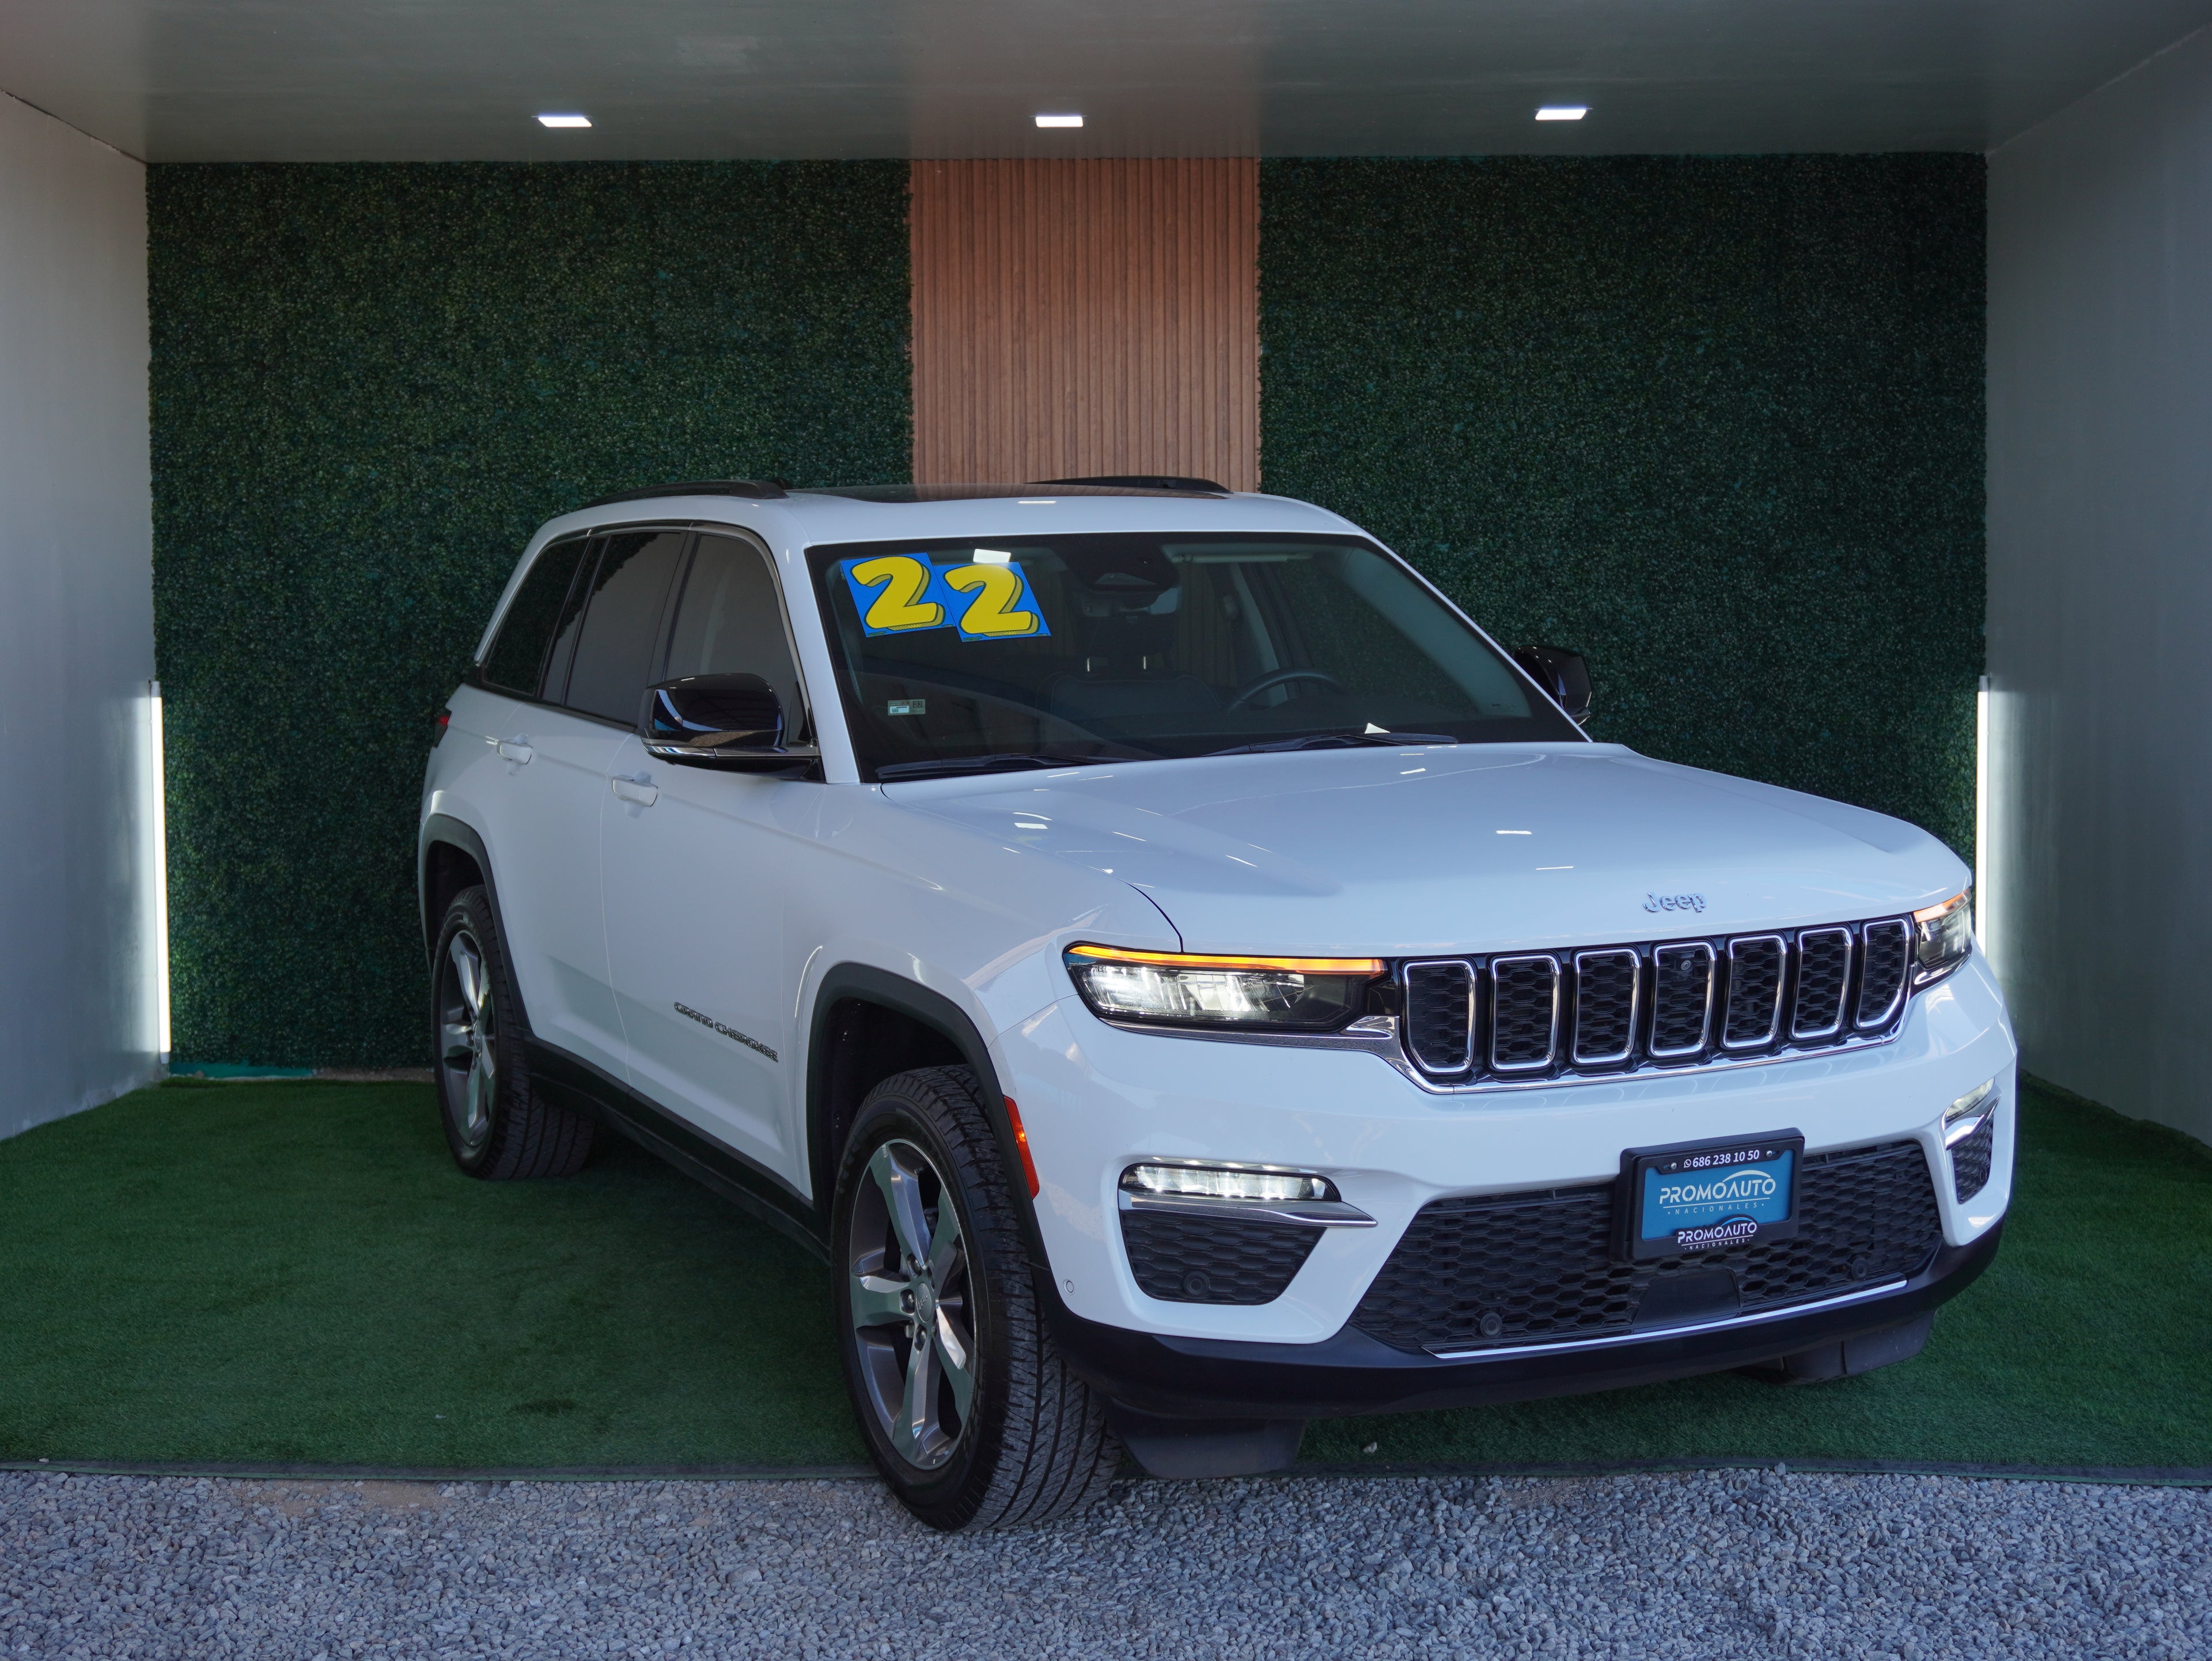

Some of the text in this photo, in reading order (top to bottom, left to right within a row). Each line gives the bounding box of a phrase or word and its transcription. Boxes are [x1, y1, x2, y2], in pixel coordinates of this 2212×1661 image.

[1642, 892, 1707, 913] Jeep
[674, 1001, 778, 1063] GRAND CHEROKEE
[1692, 1149, 1760, 1167] 686 238 10 50
[1659, 1178, 1776, 1204] PROMOAUTO
[1675, 1202, 1757, 1214] NACIONALES
[1677, 1222, 1757, 1243] PROMOAUTO
[1689, 1238, 1745, 1250] NACIONALES
